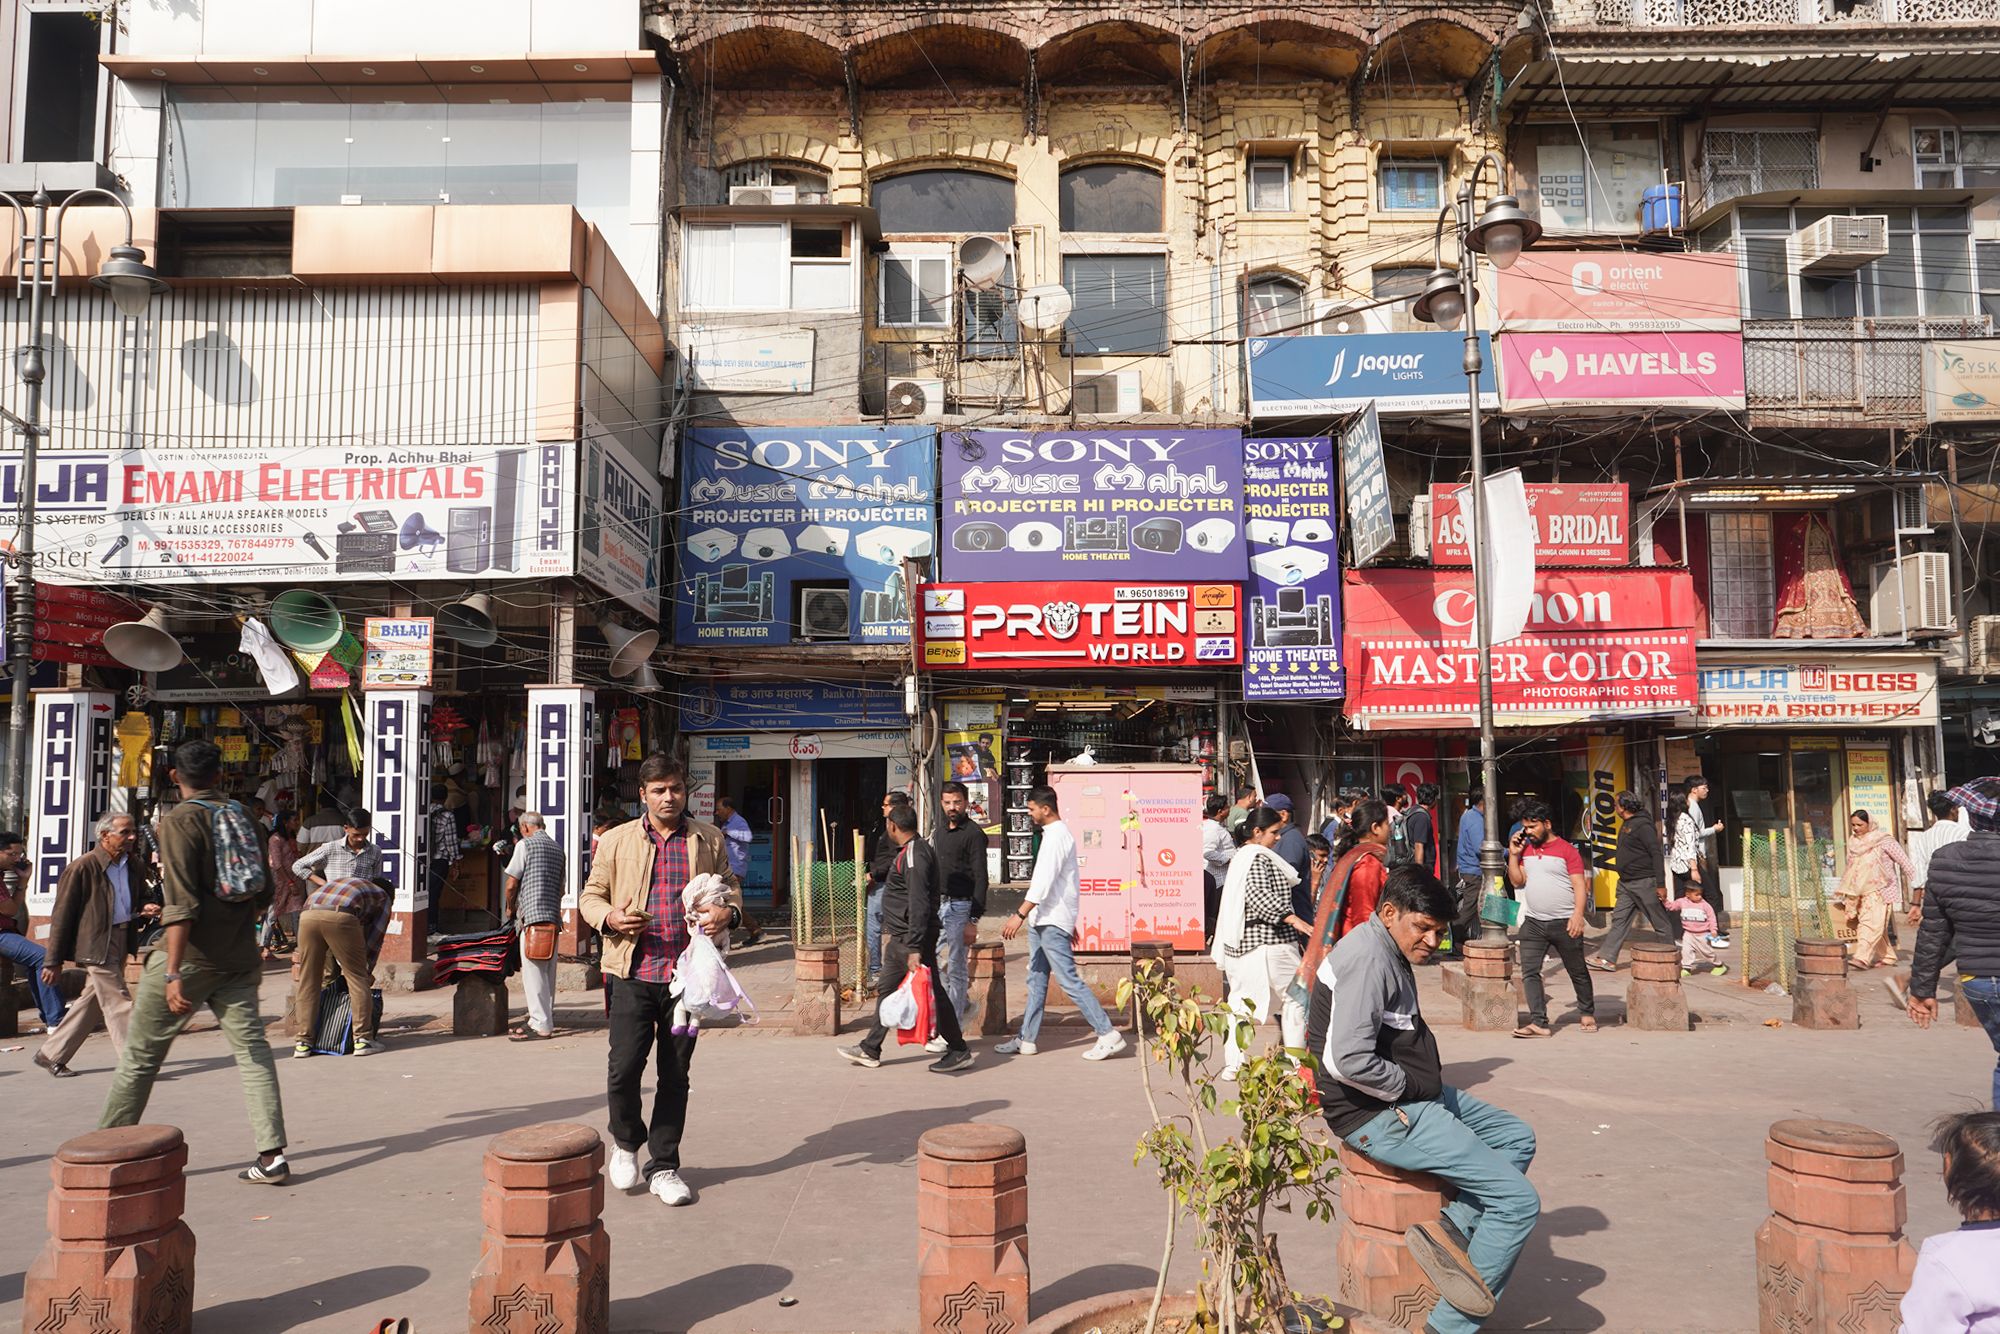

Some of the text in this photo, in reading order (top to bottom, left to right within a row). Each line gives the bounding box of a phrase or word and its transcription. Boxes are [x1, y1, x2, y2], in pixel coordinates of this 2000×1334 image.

[1609, 264, 1663, 280] orient
[1609, 280, 1648, 290] electric
[1586, 321, 1601, 329] Hub
[1351, 354, 1424, 377] Jaquar
[1576, 352, 1717, 376] HAVELLS
[1393, 371, 1424, 380] LIGHTS
[715, 439, 903, 470] SONY
[1002, 438, 1185, 463] SONY
[1245, 442, 1320, 460] SONY
[345, 453, 383, 466] Prop.
[388, 452, 434, 464] Achhu
[439, 451, 472, 464] Bhai
[0, 463, 484, 504] UJA EMAMI ELECTRICALS
[1243, 483, 1329, 497] PROJECTER
[540, 445, 561, 550] AHUJA
[604, 460, 651, 539] AHUJA
[955, 498, 1234, 513] PROJECTER HI PROJECTER
[1244, 503, 1330, 517] PROJECTER
[46, 514, 106, 525] SYSTEMS
[123, 508, 328, 521] DEALS IN ALL AHUJA SPEAKER MODELS
[693, 507, 928, 524] PROJECTER HI PROJECTER
[167, 523, 283, 535] & MUSIC ACCESSORIES
[1548, 514, 1623, 545] BRIDAL
[138, 541, 149, 551] M.
[228, 538, 294, 550] 7678449779
[177, 552, 254, 563] 011-41220024
[1062, 552, 1131, 561] HOME THEATER
[1117, 588, 1185, 598] M. 9650189619
[1433, 590, 1611, 627] Cnon
[381, 625, 429, 639] BALAJI
[698, 627, 769, 638] HOME THEATER
[861, 626, 912, 637] HOME THEA
[1088, 643, 1184, 661] WORLD
[1249, 649, 1338, 662] HOME THEATER
[1372, 651, 1677, 685] MASTER COLOR
[822, 688, 847, 700] Bank
[1523, 685, 1678, 698] PHOTOGRAPHIC STORE
[1763, 694, 1836, 703] PA SYSTEMS
[1787, 703, 1920, 716] BROTHERS
[541, 704, 567, 850] AHUJ
[89, 718, 110, 852] AHU
[40, 704, 75, 893] AHUJA
[376, 700, 403, 889] AHUJA
[417, 704, 430, 891] AHUJA
[1592, 770, 1617, 872] Nikon
[1080, 879, 1122, 892] SES
[1154, 889, 1181, 897] 19122
